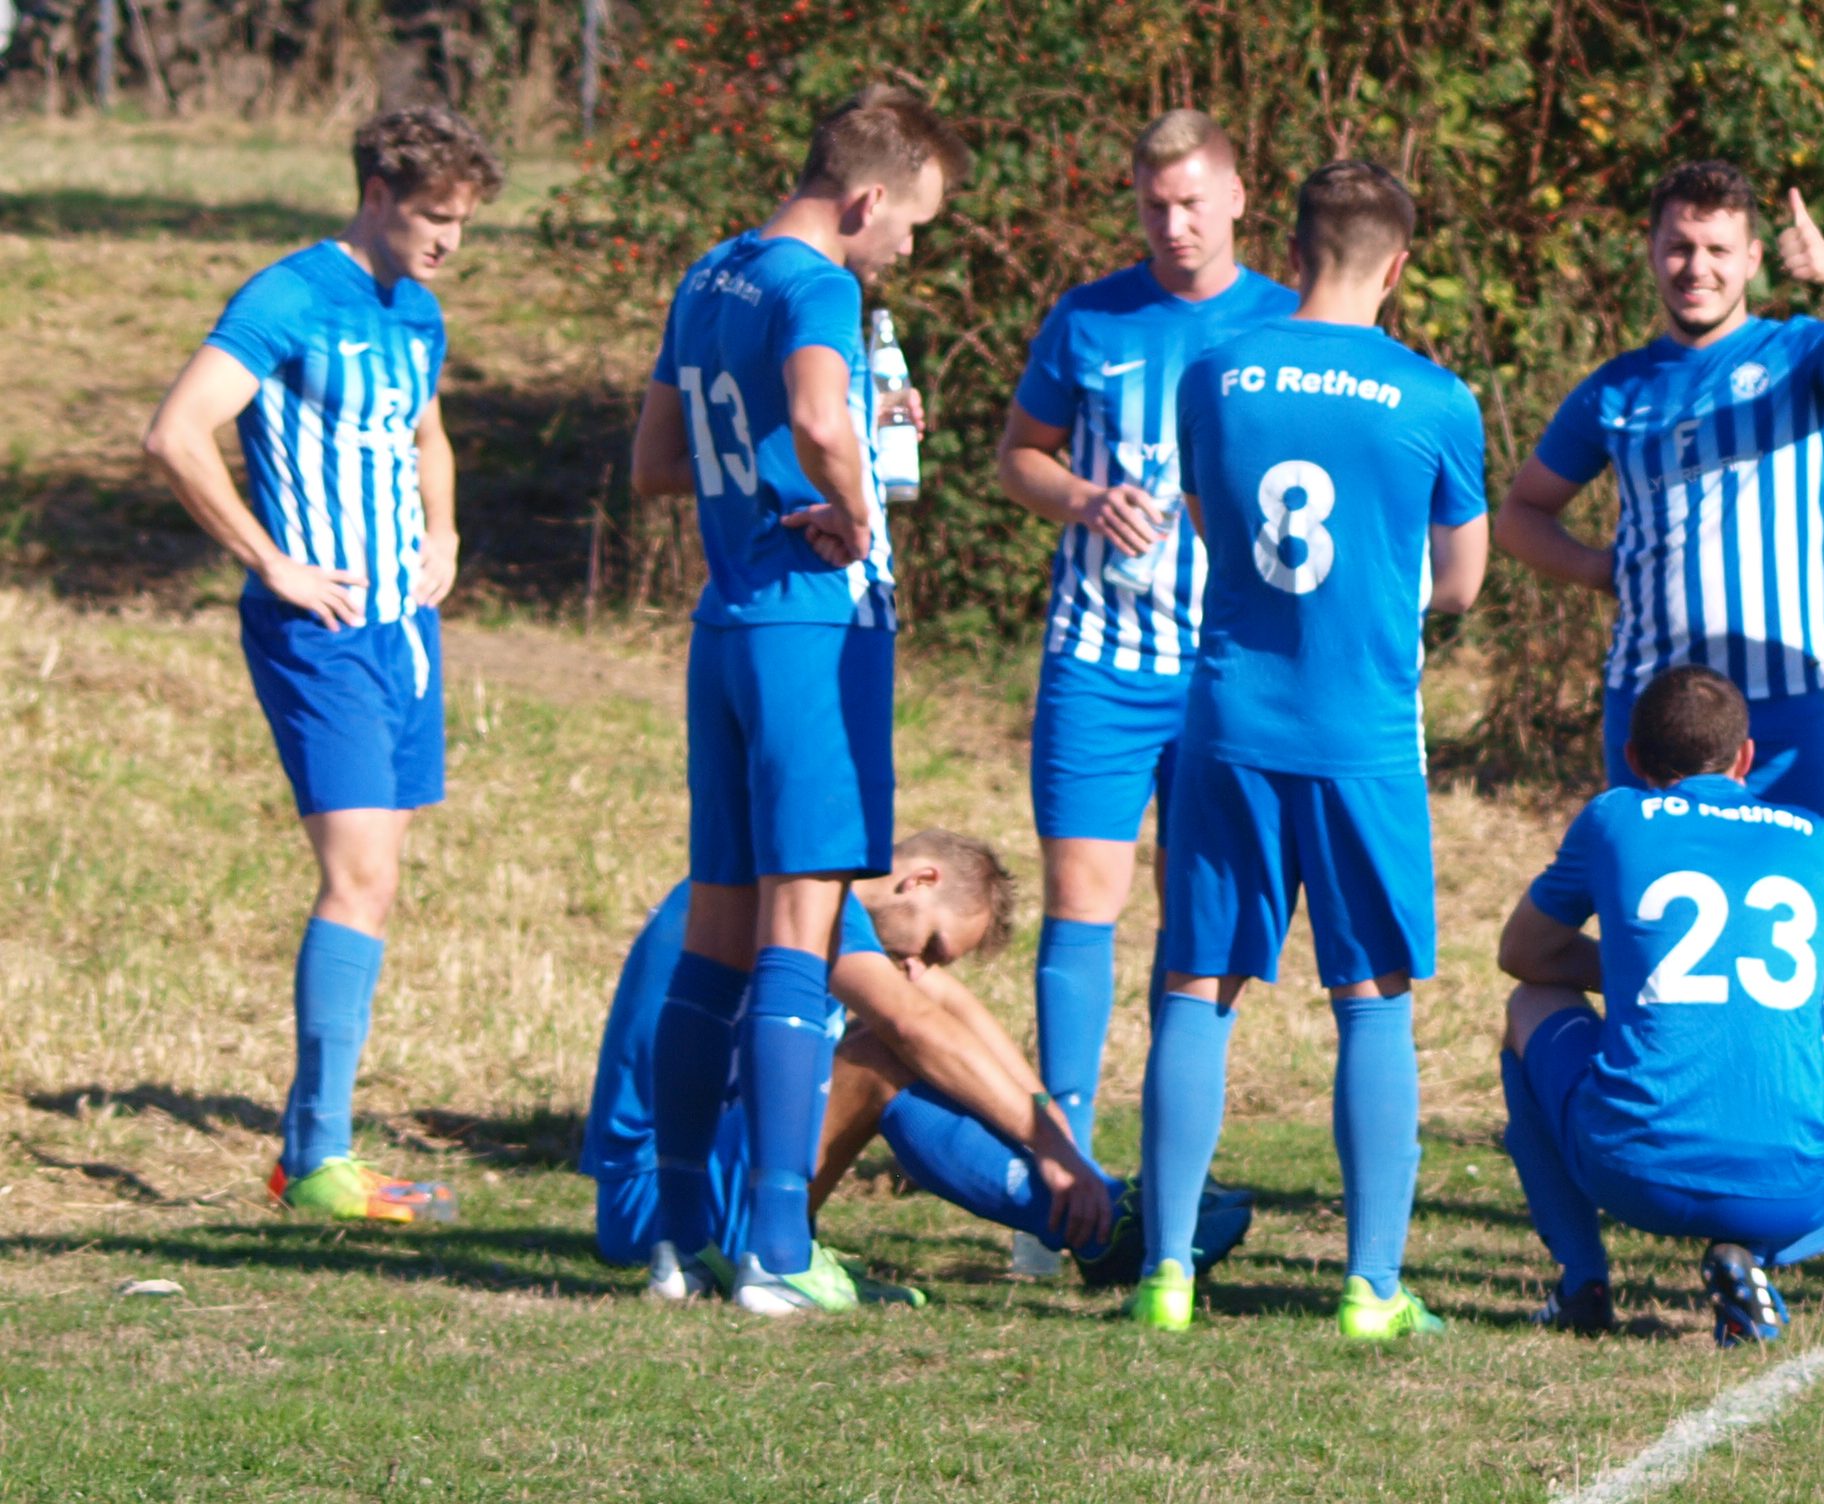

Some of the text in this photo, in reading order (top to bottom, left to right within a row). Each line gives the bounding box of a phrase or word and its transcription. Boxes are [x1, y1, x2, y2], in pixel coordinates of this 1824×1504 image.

[679, 366, 757, 497] 13
[1221, 366, 1402, 409] FC Rethen
[1254, 460, 1335, 595] 8
[1641, 796, 1690, 820] FC
[1637, 870, 1818, 1010] 23
